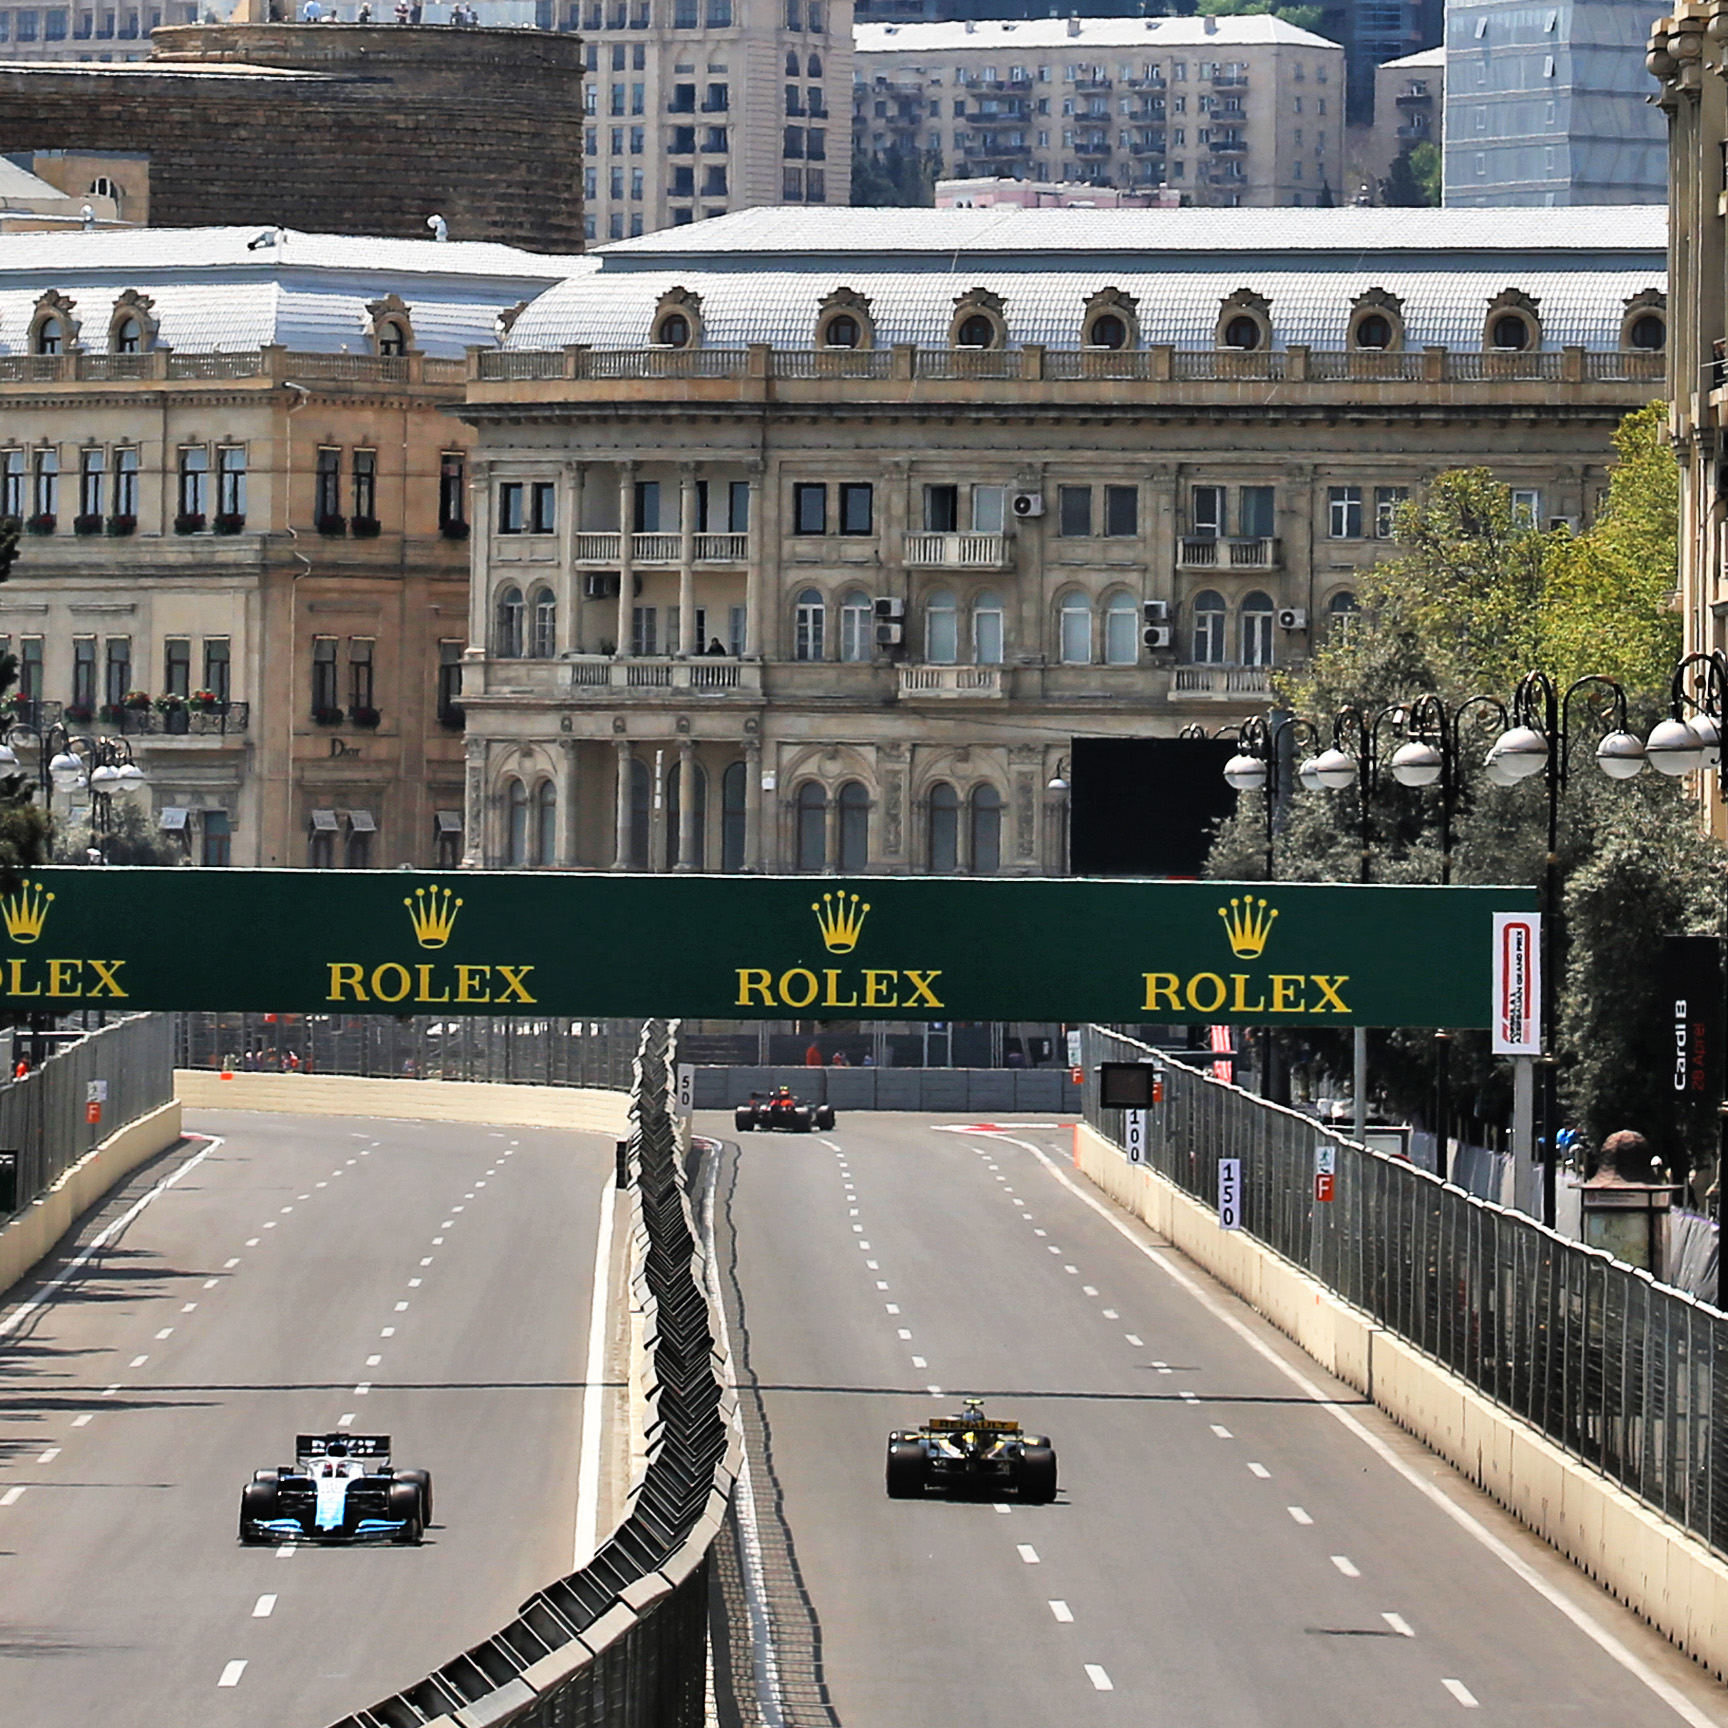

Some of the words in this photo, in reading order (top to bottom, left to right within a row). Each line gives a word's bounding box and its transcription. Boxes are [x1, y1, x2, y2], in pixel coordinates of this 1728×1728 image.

[326, 962, 538, 1004] ROLEX
[734, 968, 945, 1008] ROLEX
[1140, 972, 1352, 1014] ROLEX
[1674, 999, 1687, 1019] B
[1674, 1023, 1687, 1091] Cardi
[681, 1075, 690, 1106] 50
[1692, 1068, 1705, 1091] 28
[1129, 1110, 1140, 1162] 100
[1222, 1163, 1234, 1226] 150
[1318, 1177, 1330, 1199] F
[939, 1420, 1009, 1430] RENAULT
